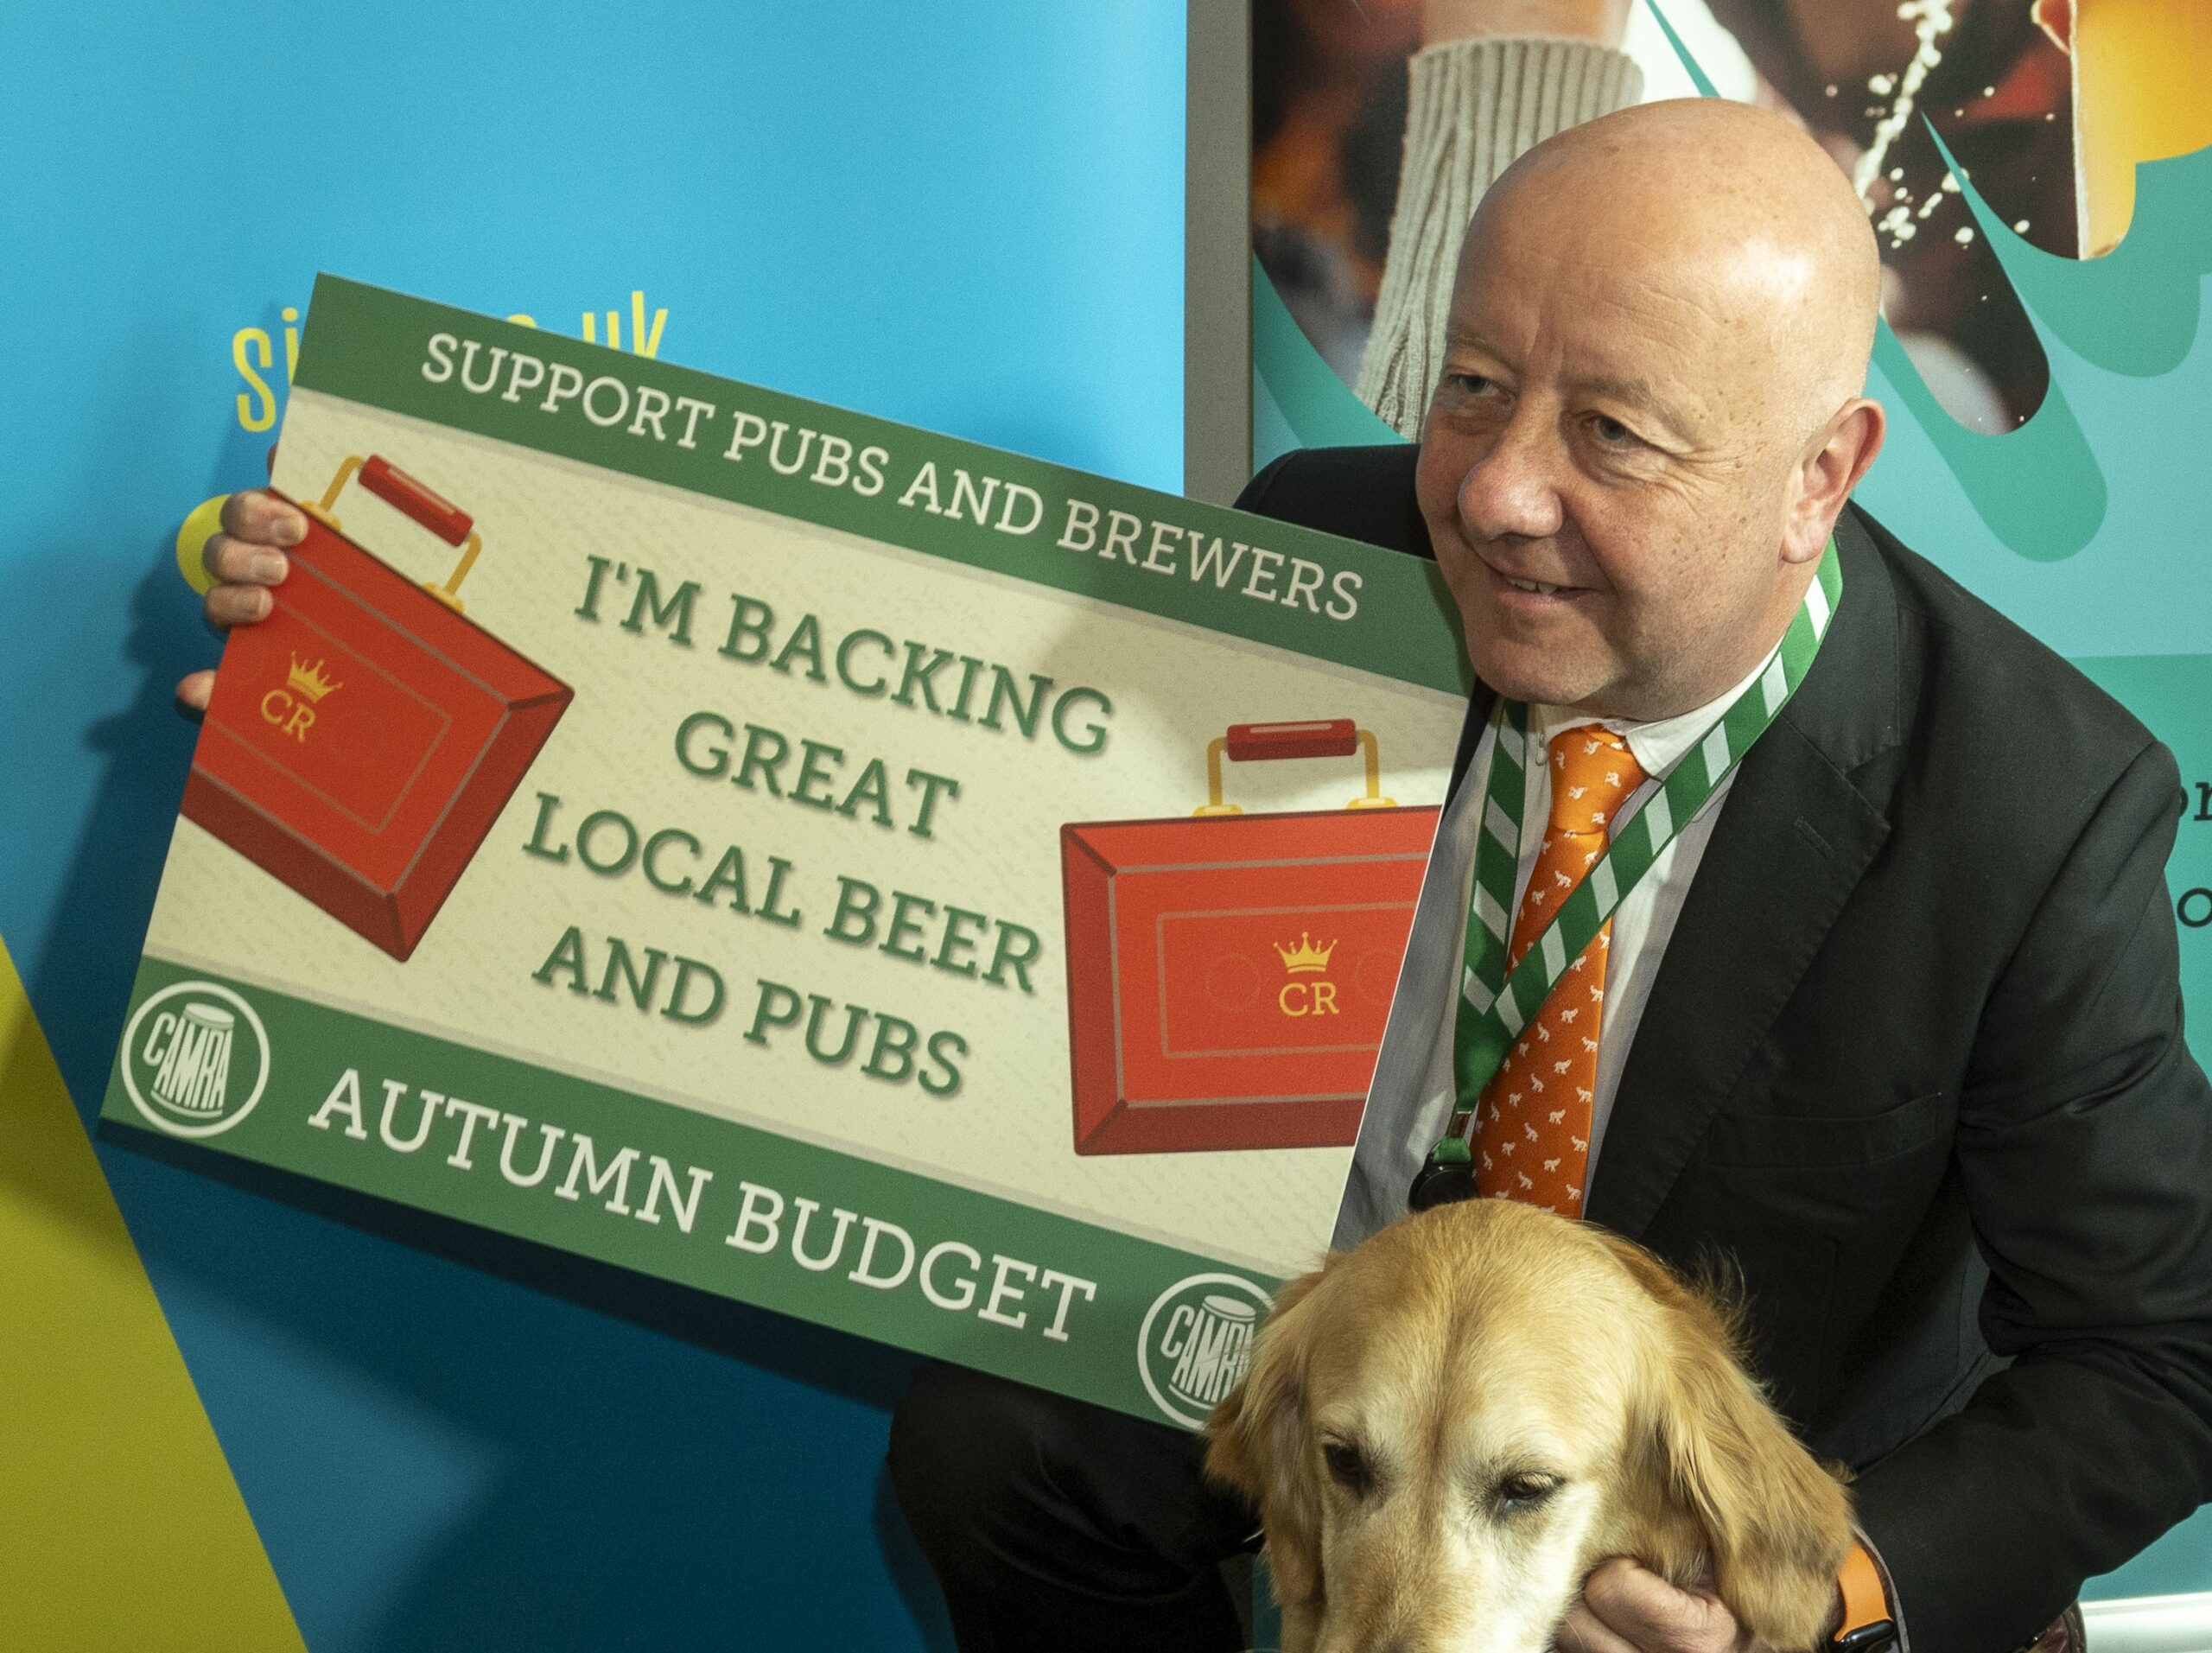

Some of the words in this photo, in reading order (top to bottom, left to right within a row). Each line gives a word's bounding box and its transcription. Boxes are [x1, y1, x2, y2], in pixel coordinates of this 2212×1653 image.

[422, 332, 716, 449] SUPPORT
[723, 410, 891, 497] PUBS
[897, 461, 1044, 536] AND
[1057, 498, 1363, 621] BREWERS
[261, 689, 315, 741] CR
[575, 555, 701, 645] I'M
[718, 594, 1114, 755] BACKING
[675, 711, 960, 838] GREAT
[523, 792, 802, 927] LOCAL
[822, 874, 1042, 994] BEER
[143, 1011, 233, 1111] CAMRA
[532, 926, 726, 1027] AND
[741, 978, 969, 1097] PUBS
[1279, 982, 1340, 1017] CR
[307, 1067, 714, 1235] AUTUMN
[725, 1180, 1098, 1343] BUDGET
